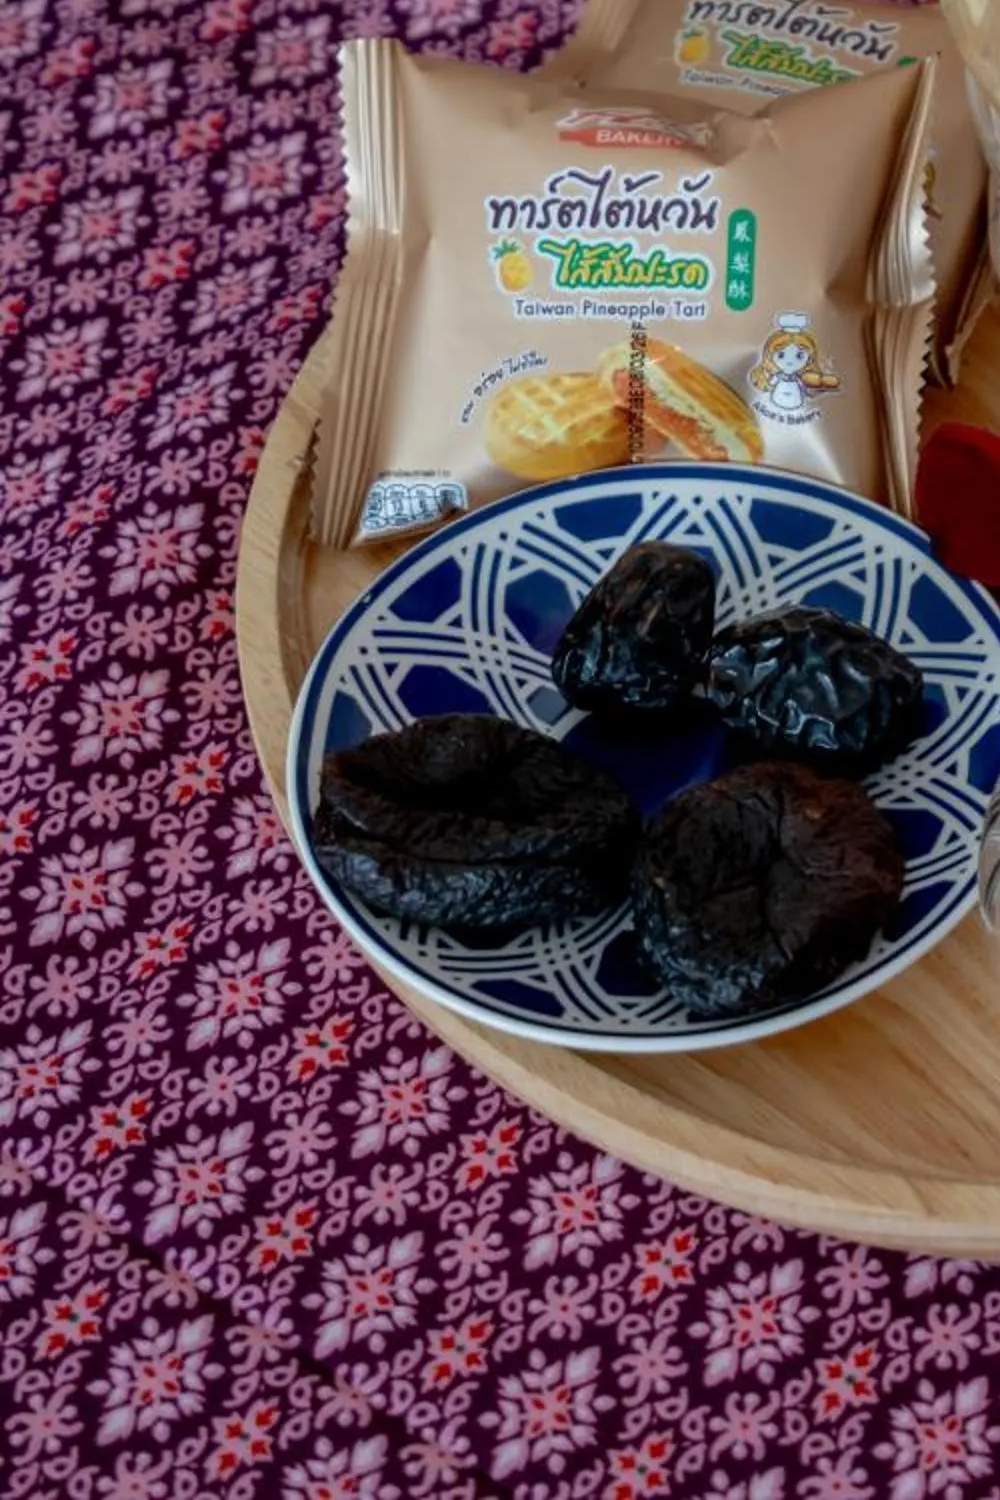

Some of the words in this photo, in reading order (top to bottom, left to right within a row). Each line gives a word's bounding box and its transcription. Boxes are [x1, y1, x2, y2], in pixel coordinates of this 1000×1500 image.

[488, 169, 719, 231] ทาร์ตไต้หวัน
[515, 299, 575, 316] Taiwan
[582, 299, 665, 319] Pineapple
[675, 300, 706, 317] Tart
